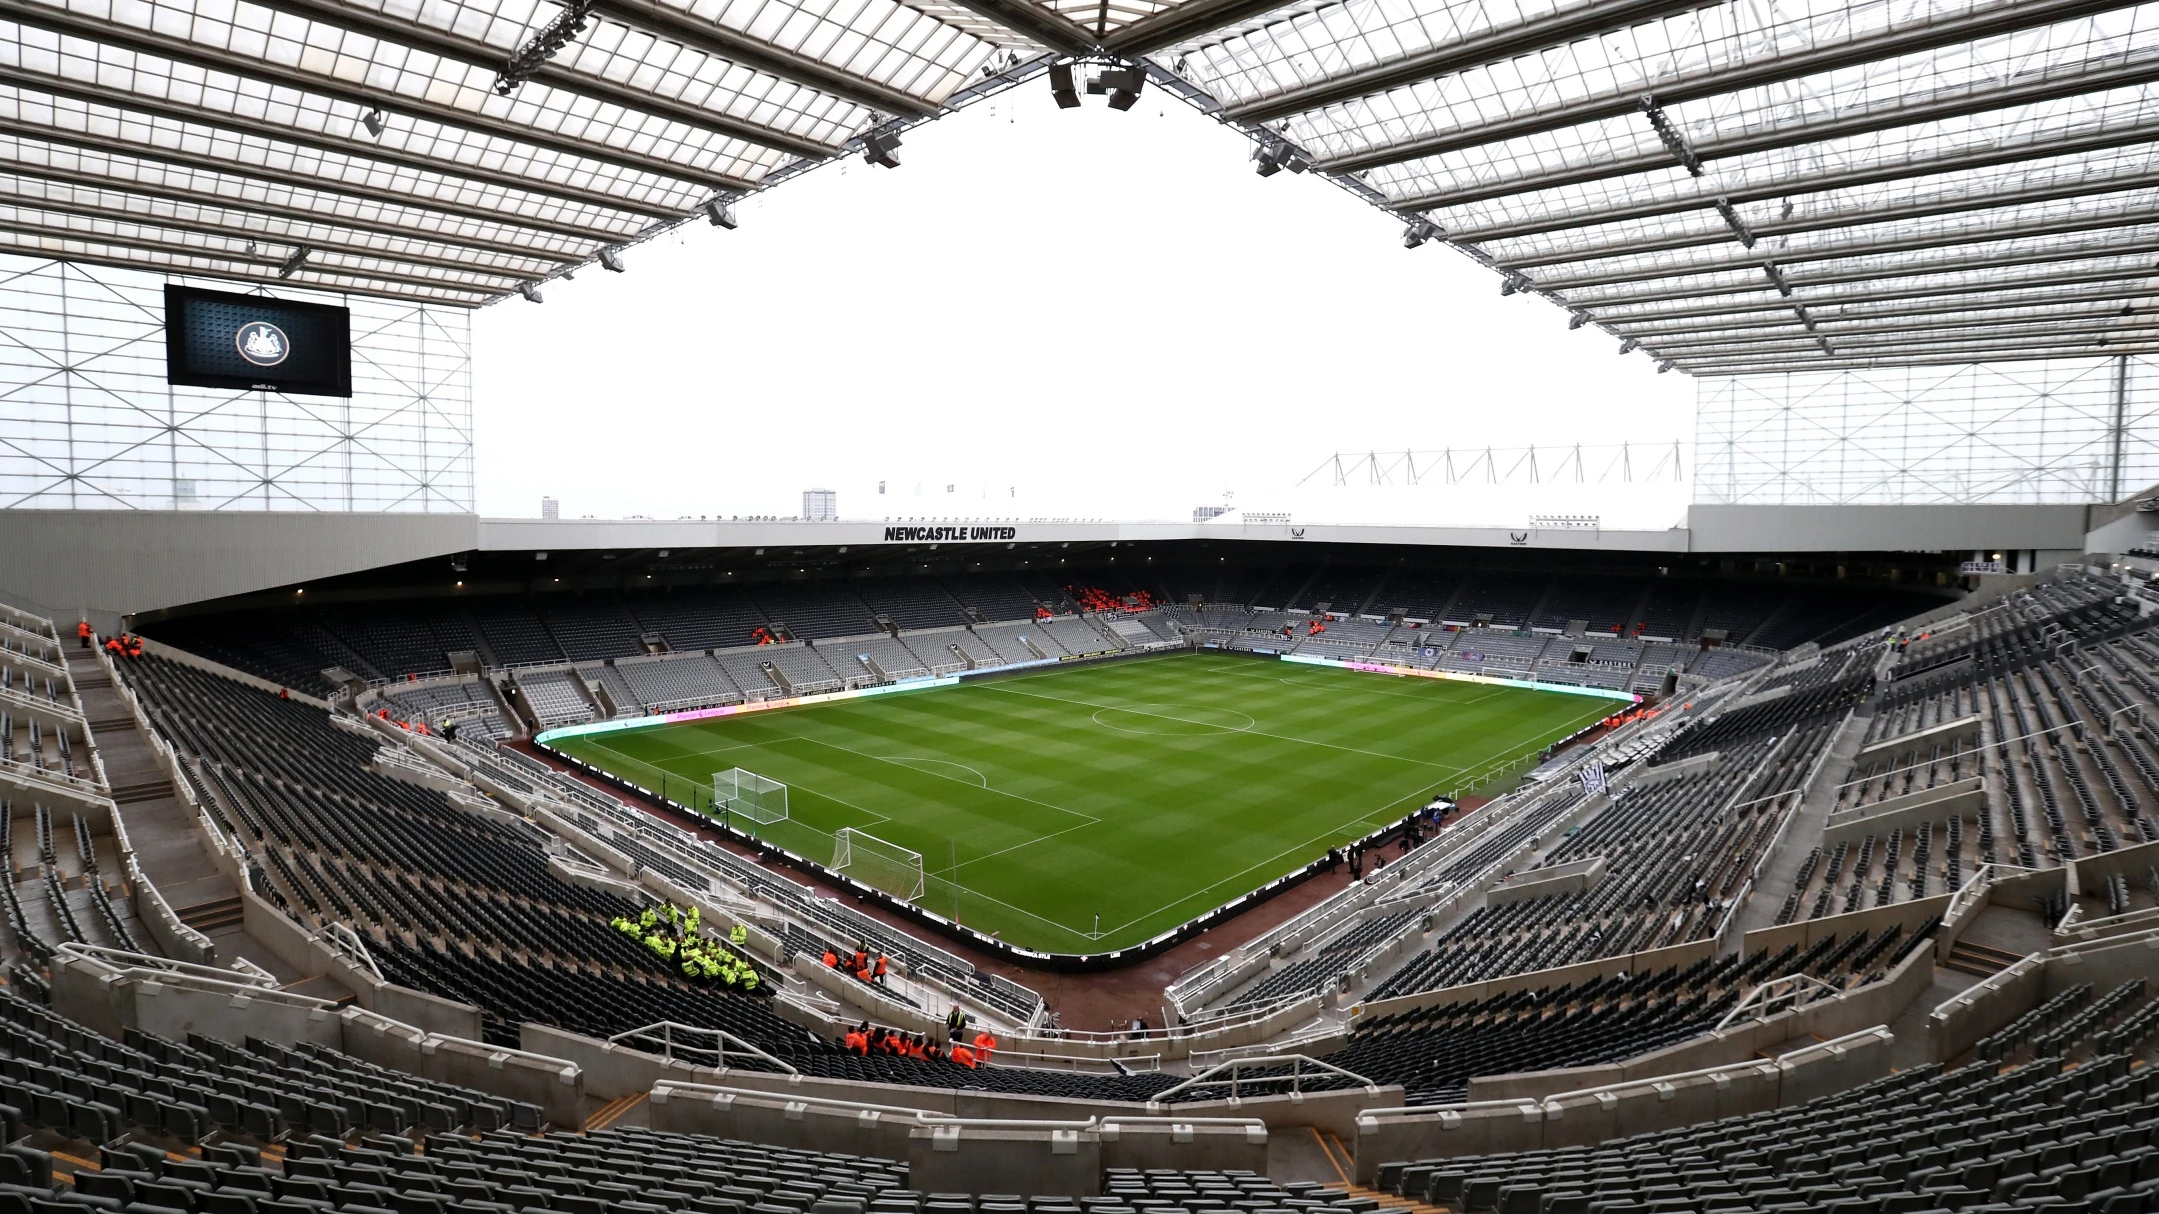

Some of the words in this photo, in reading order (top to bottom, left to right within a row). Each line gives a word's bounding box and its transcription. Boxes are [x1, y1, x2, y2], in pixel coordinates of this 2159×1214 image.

[884, 527, 968, 541] NEWCASTLE
[970, 527, 1016, 540] UNITED
[771, 700, 790, 708] Leagu
[677, 711, 698, 719] Premier
